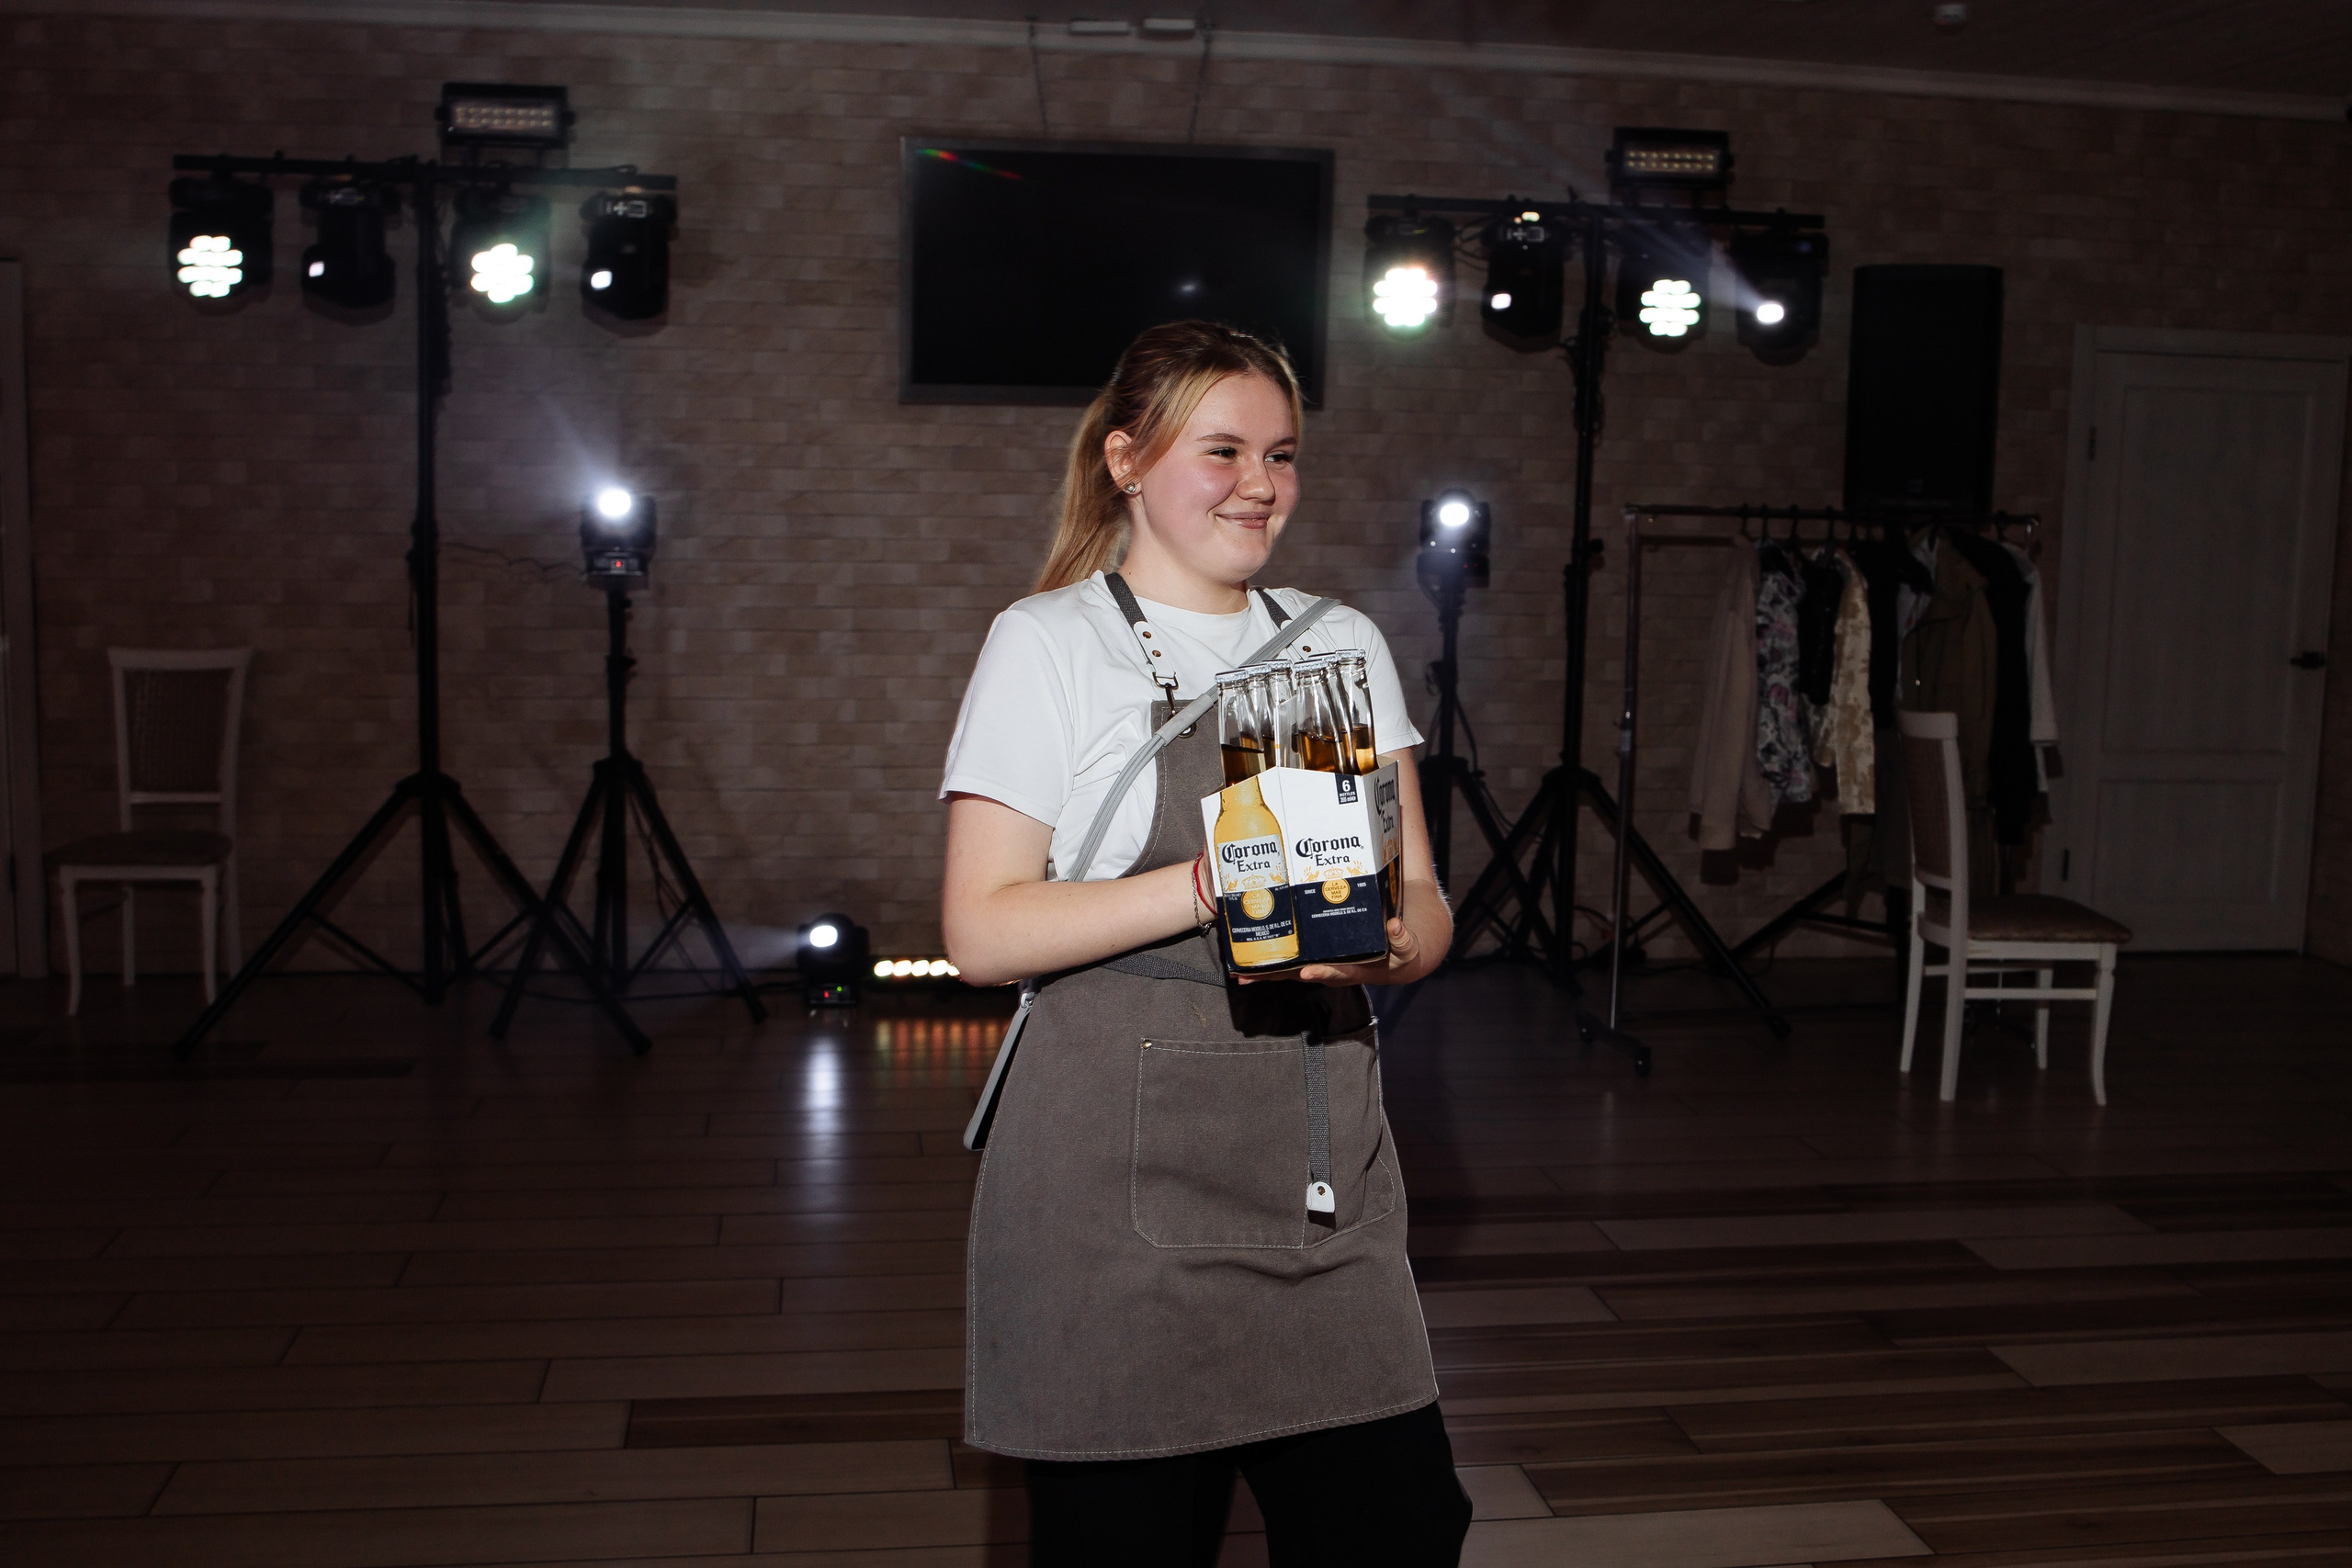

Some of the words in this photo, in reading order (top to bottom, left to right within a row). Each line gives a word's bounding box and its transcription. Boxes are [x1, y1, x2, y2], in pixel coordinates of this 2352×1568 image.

[1342, 780, 1351, 792] 6
[1222, 841, 1277, 864] Corona
[1295, 836, 1361, 859] Corona
[1315, 853, 1351, 866] Extra
[1237, 860, 1271, 873] Extra
